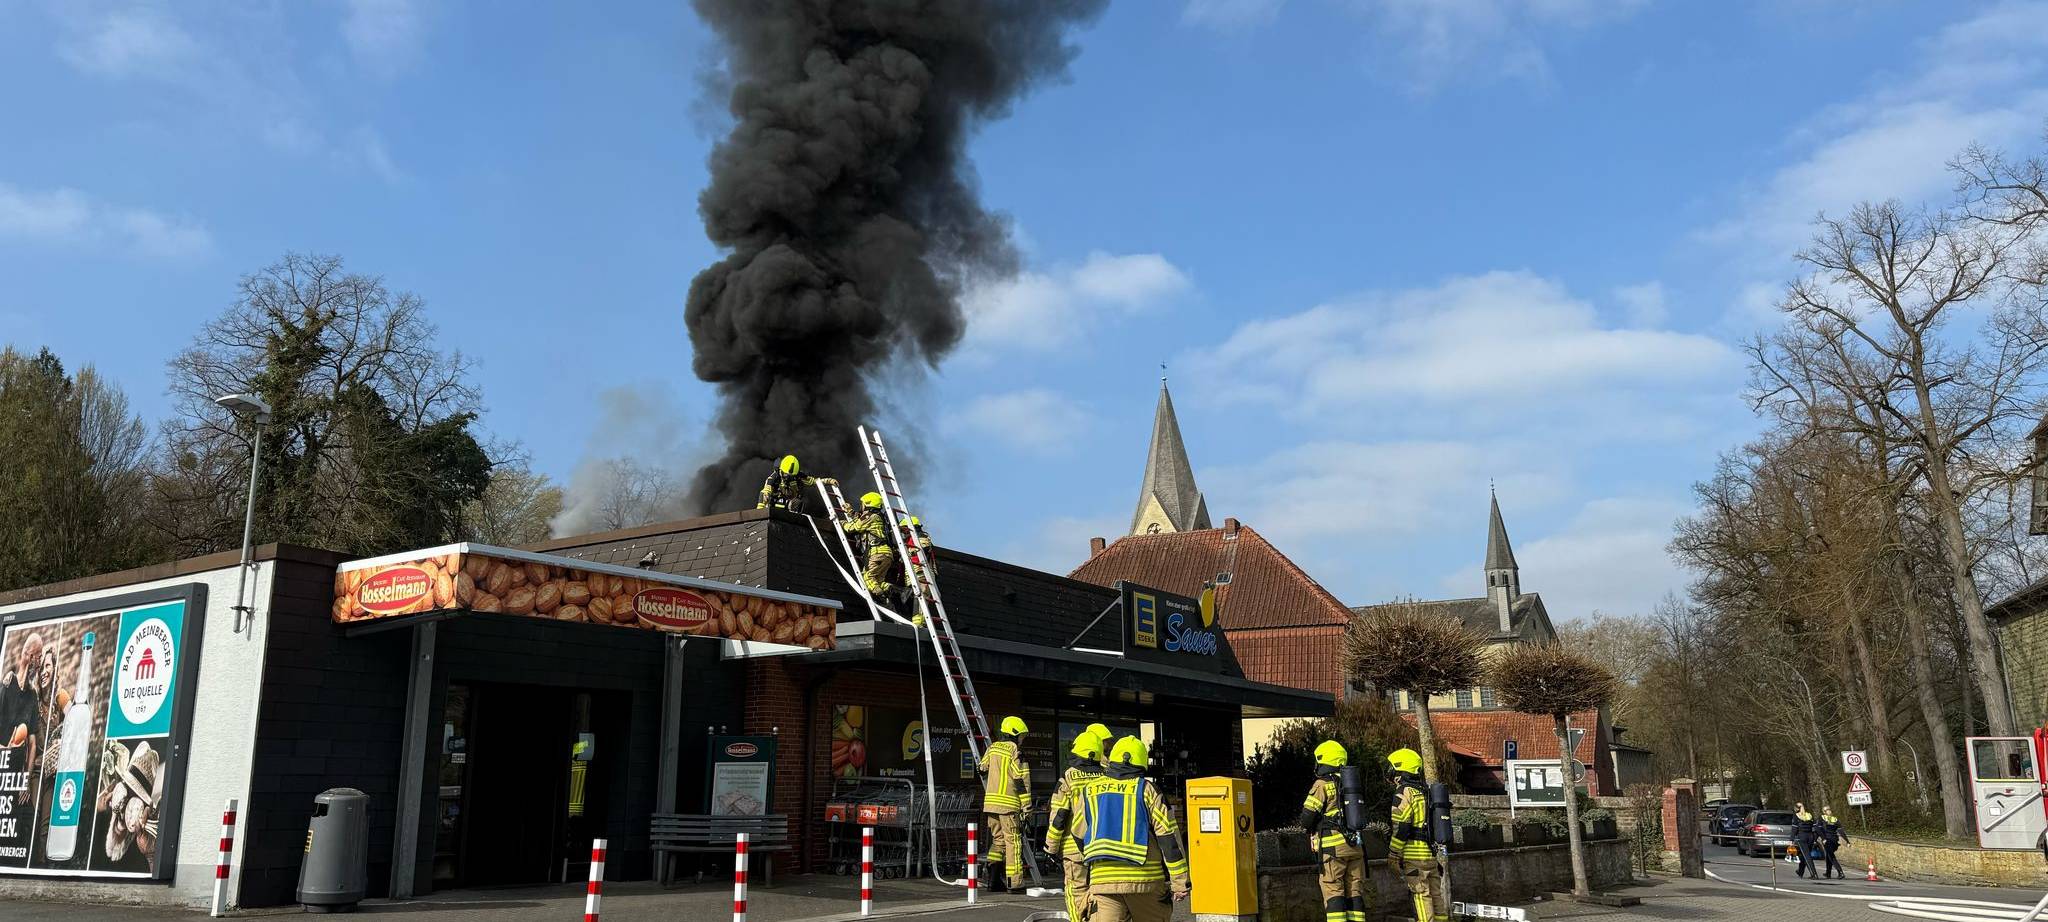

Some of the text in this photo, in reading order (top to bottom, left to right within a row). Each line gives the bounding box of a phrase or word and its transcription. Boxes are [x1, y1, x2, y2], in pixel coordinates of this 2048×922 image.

[360, 576, 427, 604] Hosselmann
[637, 595, 708, 621] Hosselmann
[1137, 597, 1154, 634] E
[1165, 612, 1217, 656] Sauer
[122, 624, 171, 672] BAD MEINBERGER
[123, 684, 163, 700] DIE QUELLE
[135, 706, 147, 714] 1767
[1507, 741, 1516, 758] P
[0, 750, 11, 769] IE
[1850, 756, 1859, 764] 30
[1096, 783, 1127, 793] TSF-W
[0, 818, 18, 838] EN.
